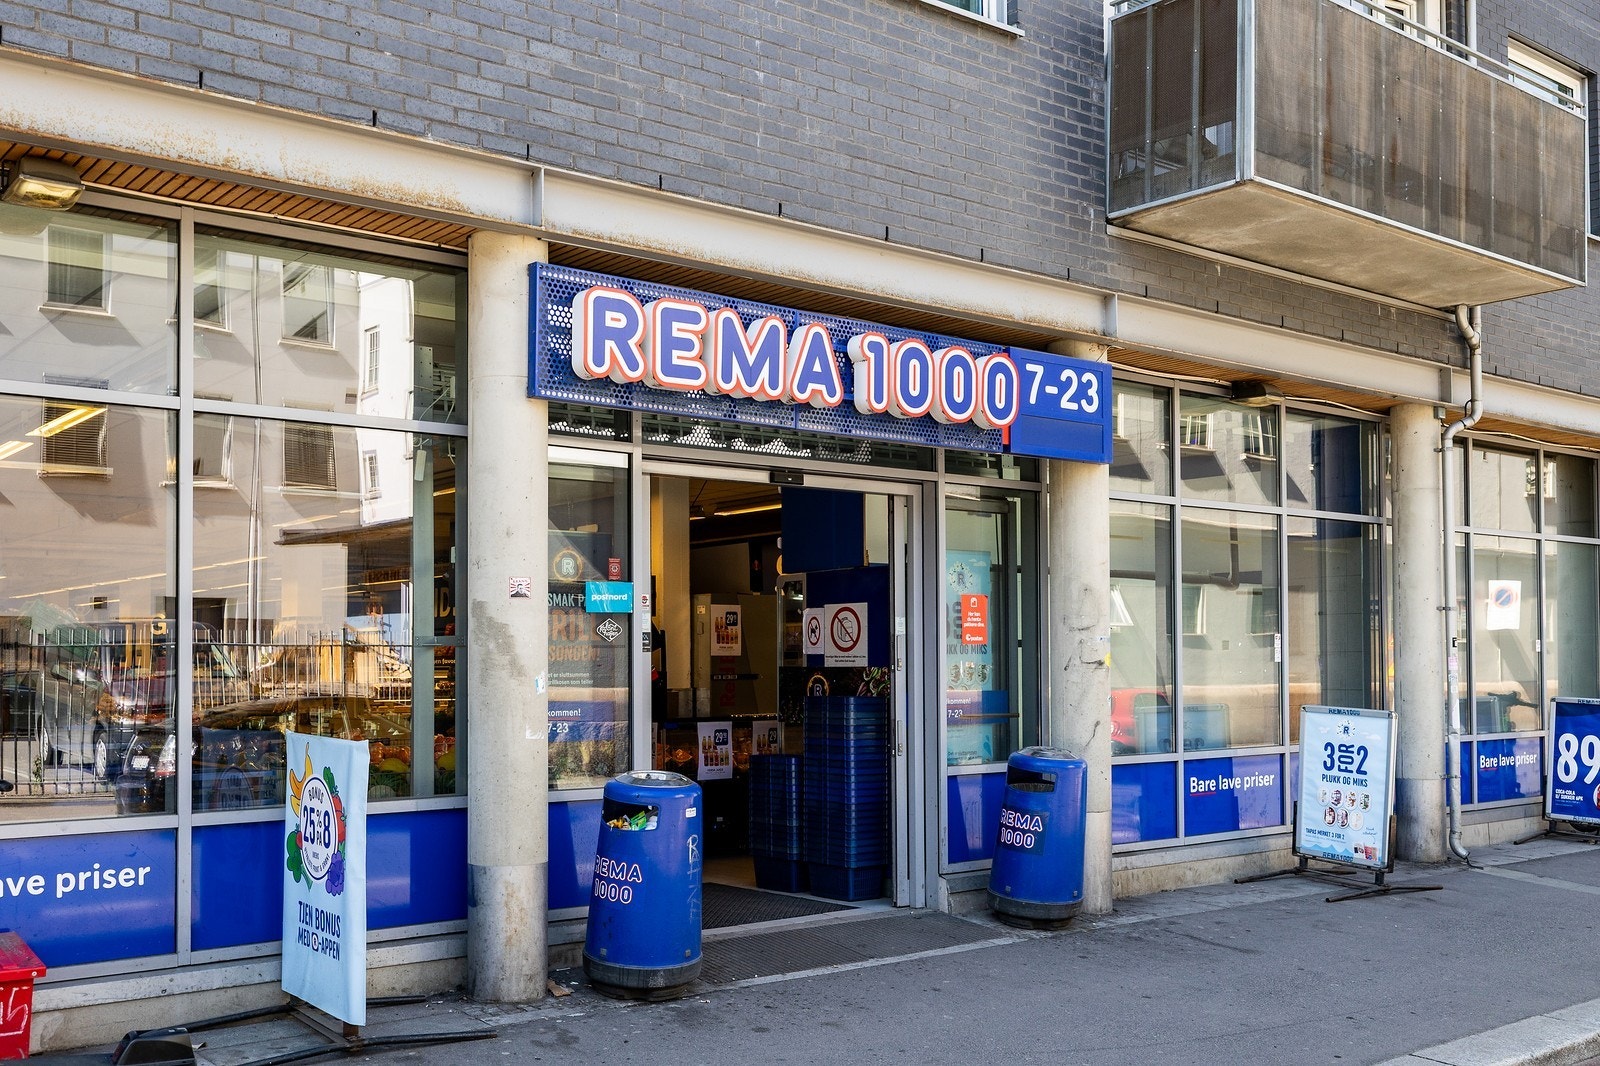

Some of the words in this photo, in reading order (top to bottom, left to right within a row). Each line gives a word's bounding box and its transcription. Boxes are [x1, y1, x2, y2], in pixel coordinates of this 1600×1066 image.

[573, 286, 844, 408] REMA
[848, 331, 1019, 429] 1000
[1025, 363, 1099, 413] 7-23
[1323, 742, 1335, 771] 3
[1337, 744, 1355, 773] FOR
[1356, 745, 1368, 775] 2
[1480, 755, 1498, 768] Bare
[1499, 754, 1515, 766] lave
[1515, 752, 1537, 767] priser
[1557, 733, 1600, 784] 89
[308, 786, 324, 804] BONUS
[1190, 777, 1216, 793] Bare
[1219, 774, 1241, 790] lave
[1243, 771, 1275, 791] priser
[1321, 774, 1342, 784] PLUKK
[1342, 776, 1351, 785] OG
[1352, 778, 1368, 787] MIKS
[303, 805, 316, 845] 25
[323, 810, 331, 849] 8
[1001, 827, 1035, 849] 1000
[56, 863, 151, 899] priser
[594, 878, 632, 904] 1000
[298, 900, 313, 927] TJEN
[315, 907, 341, 939] BONUS
[297, 926, 310, 947] MED
